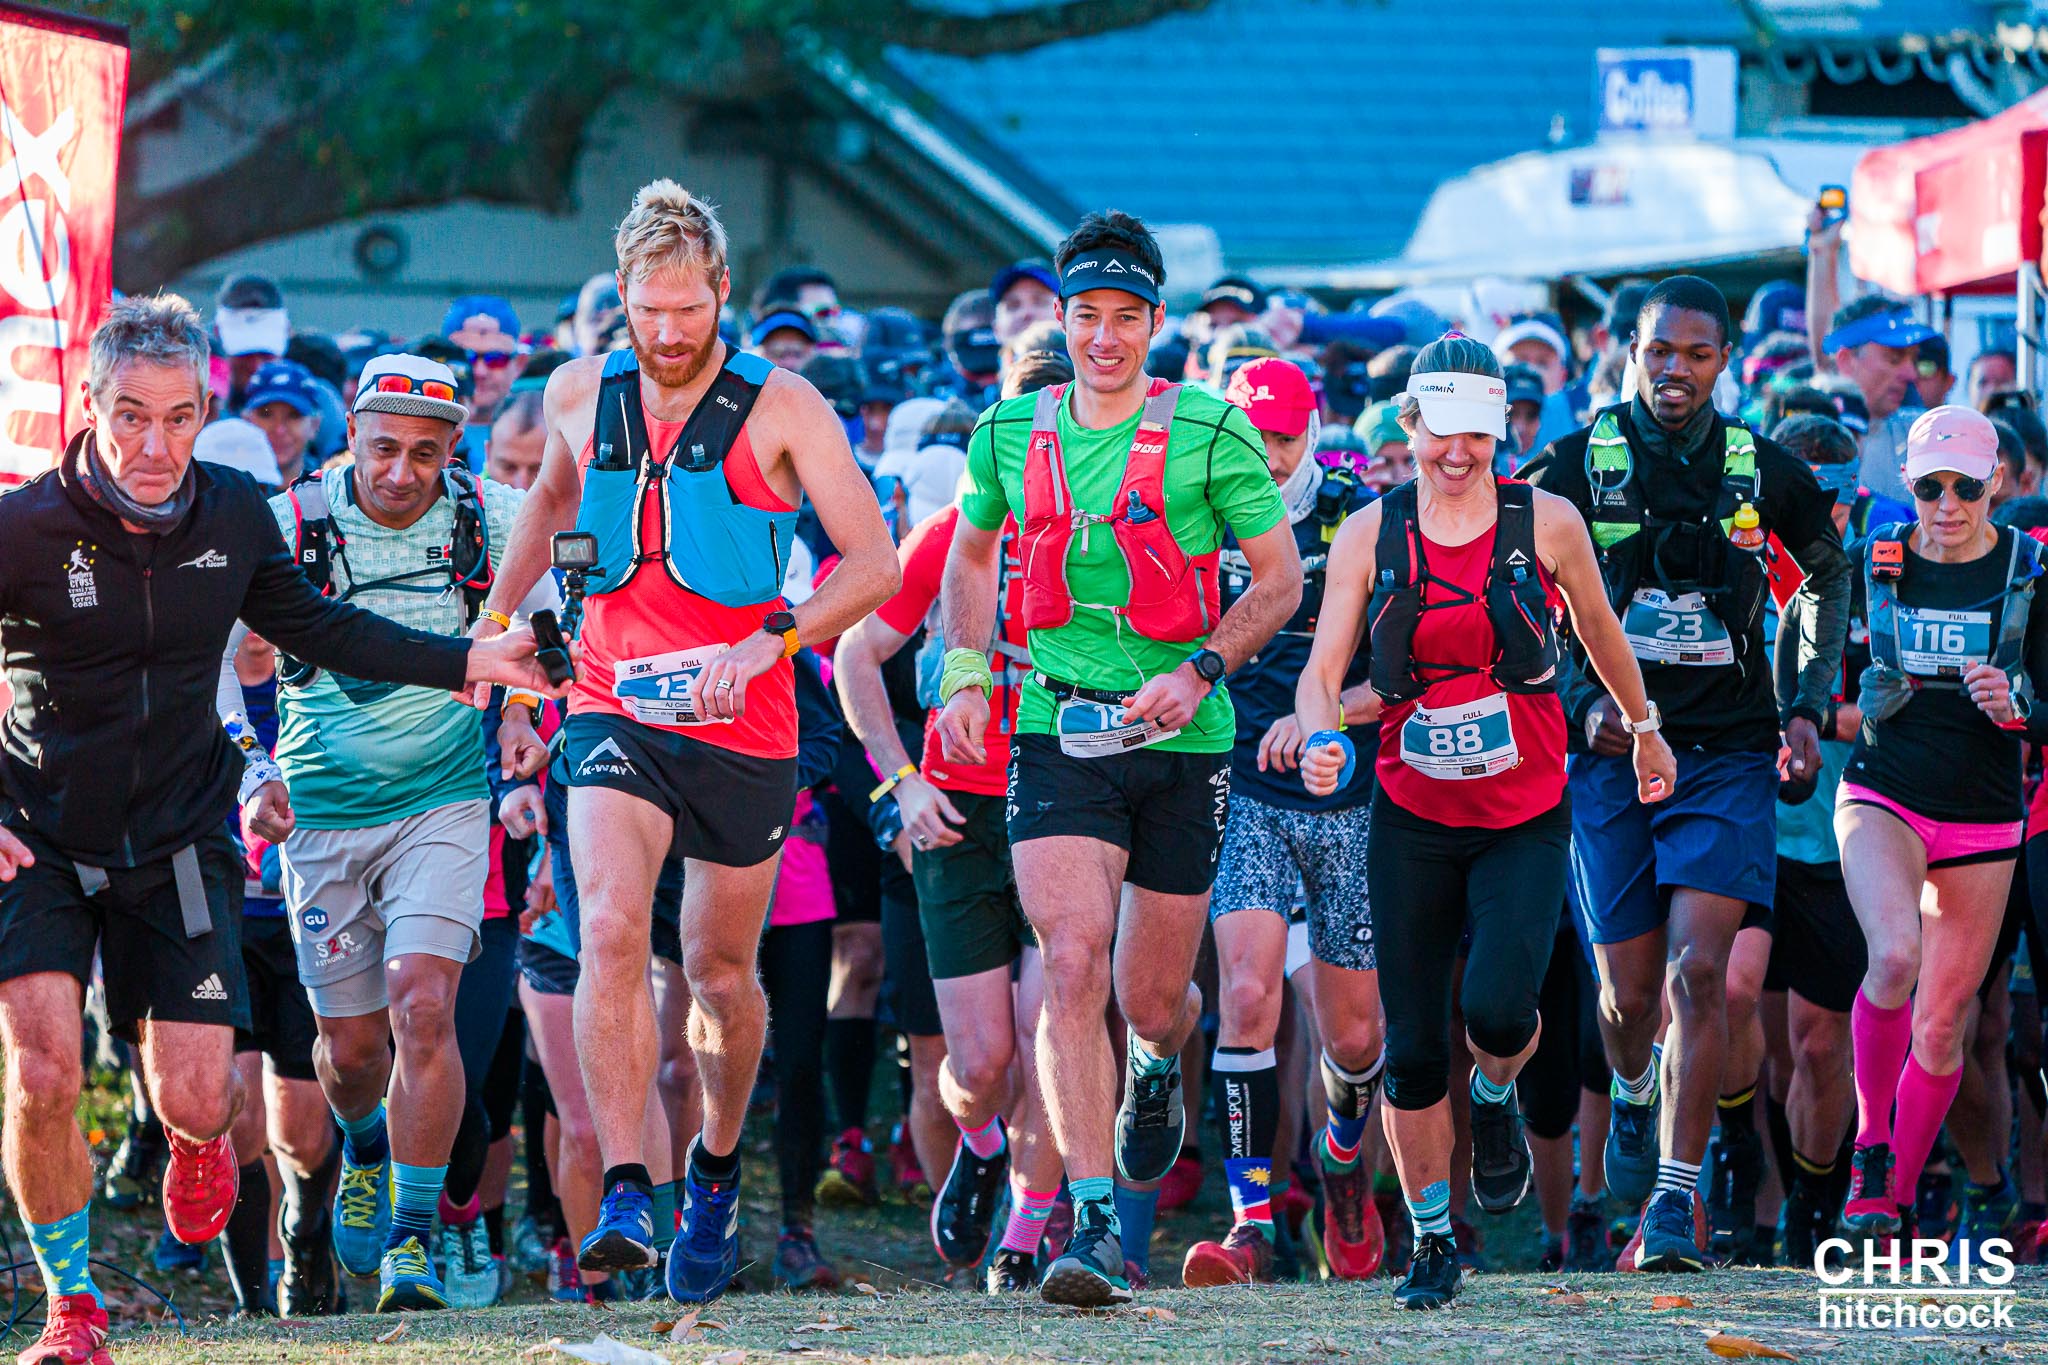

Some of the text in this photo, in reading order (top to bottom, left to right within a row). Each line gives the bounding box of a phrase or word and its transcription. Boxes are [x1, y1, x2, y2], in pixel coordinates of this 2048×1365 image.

[1420, 383, 1454, 394] GARMIN
[1949, 613, 1968, 621] FULL
[1656, 612, 1702, 640] 23
[1912, 622, 1965, 654] 116
[681, 659, 702, 669] FULL
[656, 673, 694, 699] 13
[1463, 710, 1484, 721] FULL
[1428, 723, 1484, 756] 88
[582, 764, 628, 776] K-WAY
[304, 915, 326, 926] GU
[315, 931, 355, 958] S2R
[191, 989, 228, 1000] adidas
